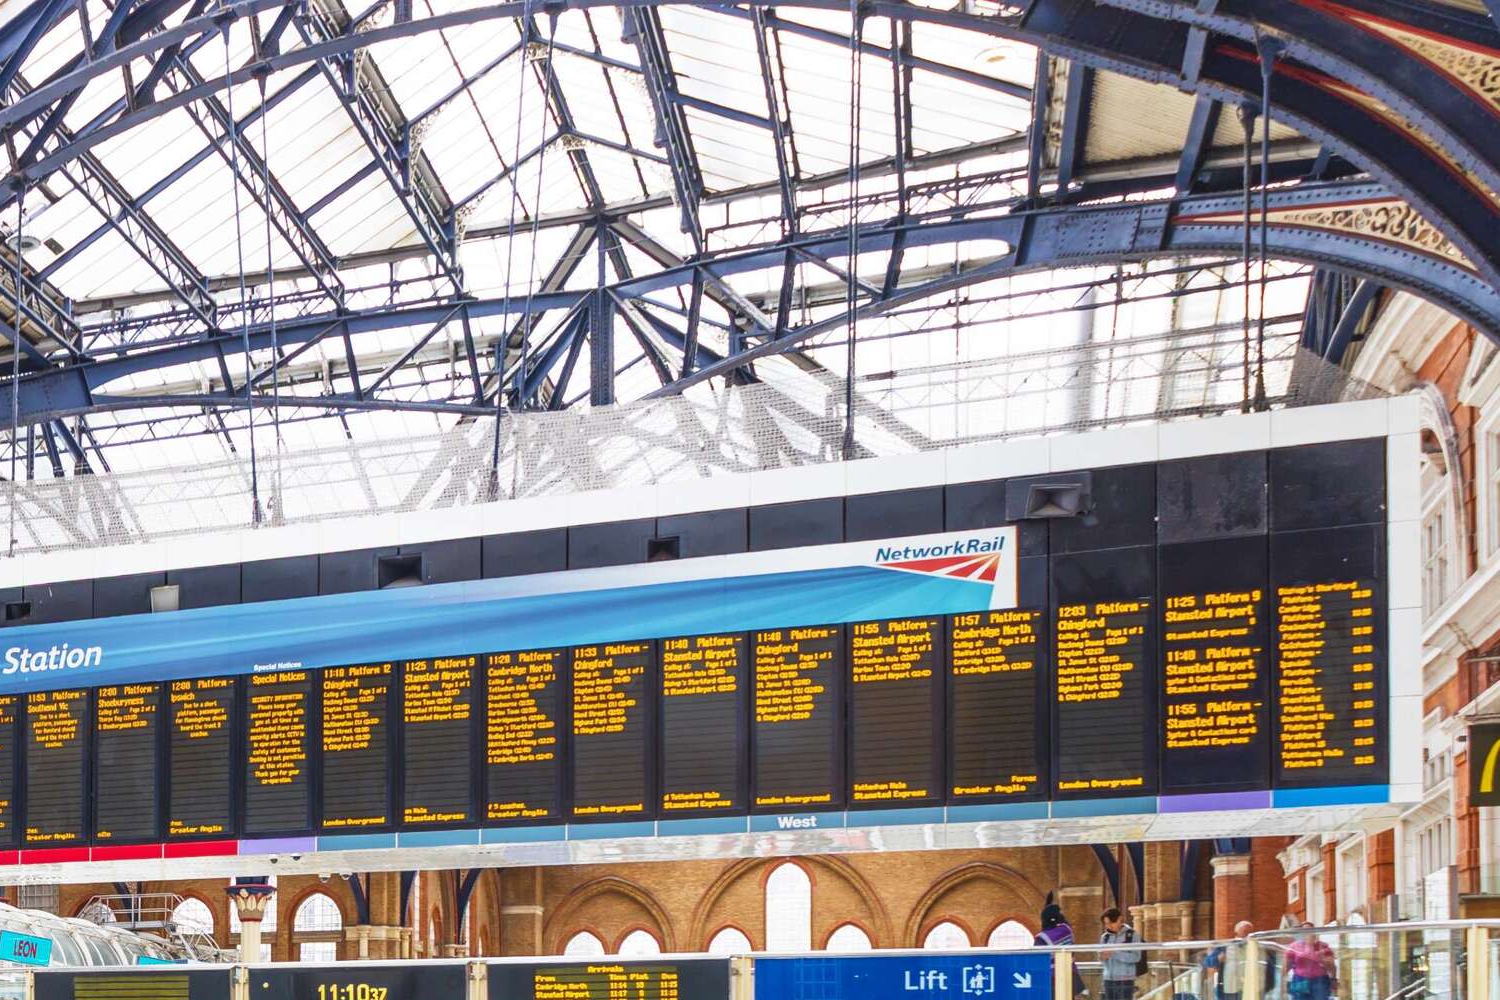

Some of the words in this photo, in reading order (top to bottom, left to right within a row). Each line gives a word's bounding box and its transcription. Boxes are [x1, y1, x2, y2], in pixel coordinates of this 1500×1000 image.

[875, 536, 1005, 562] NetworkRail
[1166, 596, 1195, 608] 11:25
[1252, 590, 1260, 601] 9
[954, 615, 980, 626] 11:57
[1165, 609, 1214, 623] Stansted
[1217, 605, 1253, 618] Airport
[854, 624, 879, 635] 11:55
[1058, 618, 1105, 631] Chingford
[953, 627, 1000, 640] Cambridge
[1003, 624, 1031, 635] North
[853, 636, 895, 648] Stansted
[897, 633, 931, 644] Airport
[574, 647, 597, 658] 11:33
[756, 642, 798, 654] Chingford
[2, 645, 101, 674] Station
[664, 651, 704, 662] Stansted
[706, 648, 736, 659] Airport
[253, 664, 277, 672] Special
[278, 661, 301, 669] Notices
[383, 664, 391, 673] 12
[406, 662, 426, 672] 11:25
[469, 658, 475, 667] 9
[488, 665, 527, 677] Cambridge
[529, 663, 552, 673] North
[574, 659, 613, 670] Chingford
[1166, 663, 1215, 676] Stansted
[1217, 659, 1254, 673] Airport
[253, 675, 278, 685] Special
[279, 672, 305, 682] Notices
[405, 673, 440, 683] Stansted
[442, 670, 470, 680] Airport
[324, 679, 358, 690] Chingford
[1167, 703, 1196, 715] 11:55
[1167, 717, 1215, 730] Stansted
[1217, 714, 1255, 727] Airport
[778, 816, 817, 828] West
[14, 941, 37, 958] LEON
[905, 970, 948, 990] Lift
